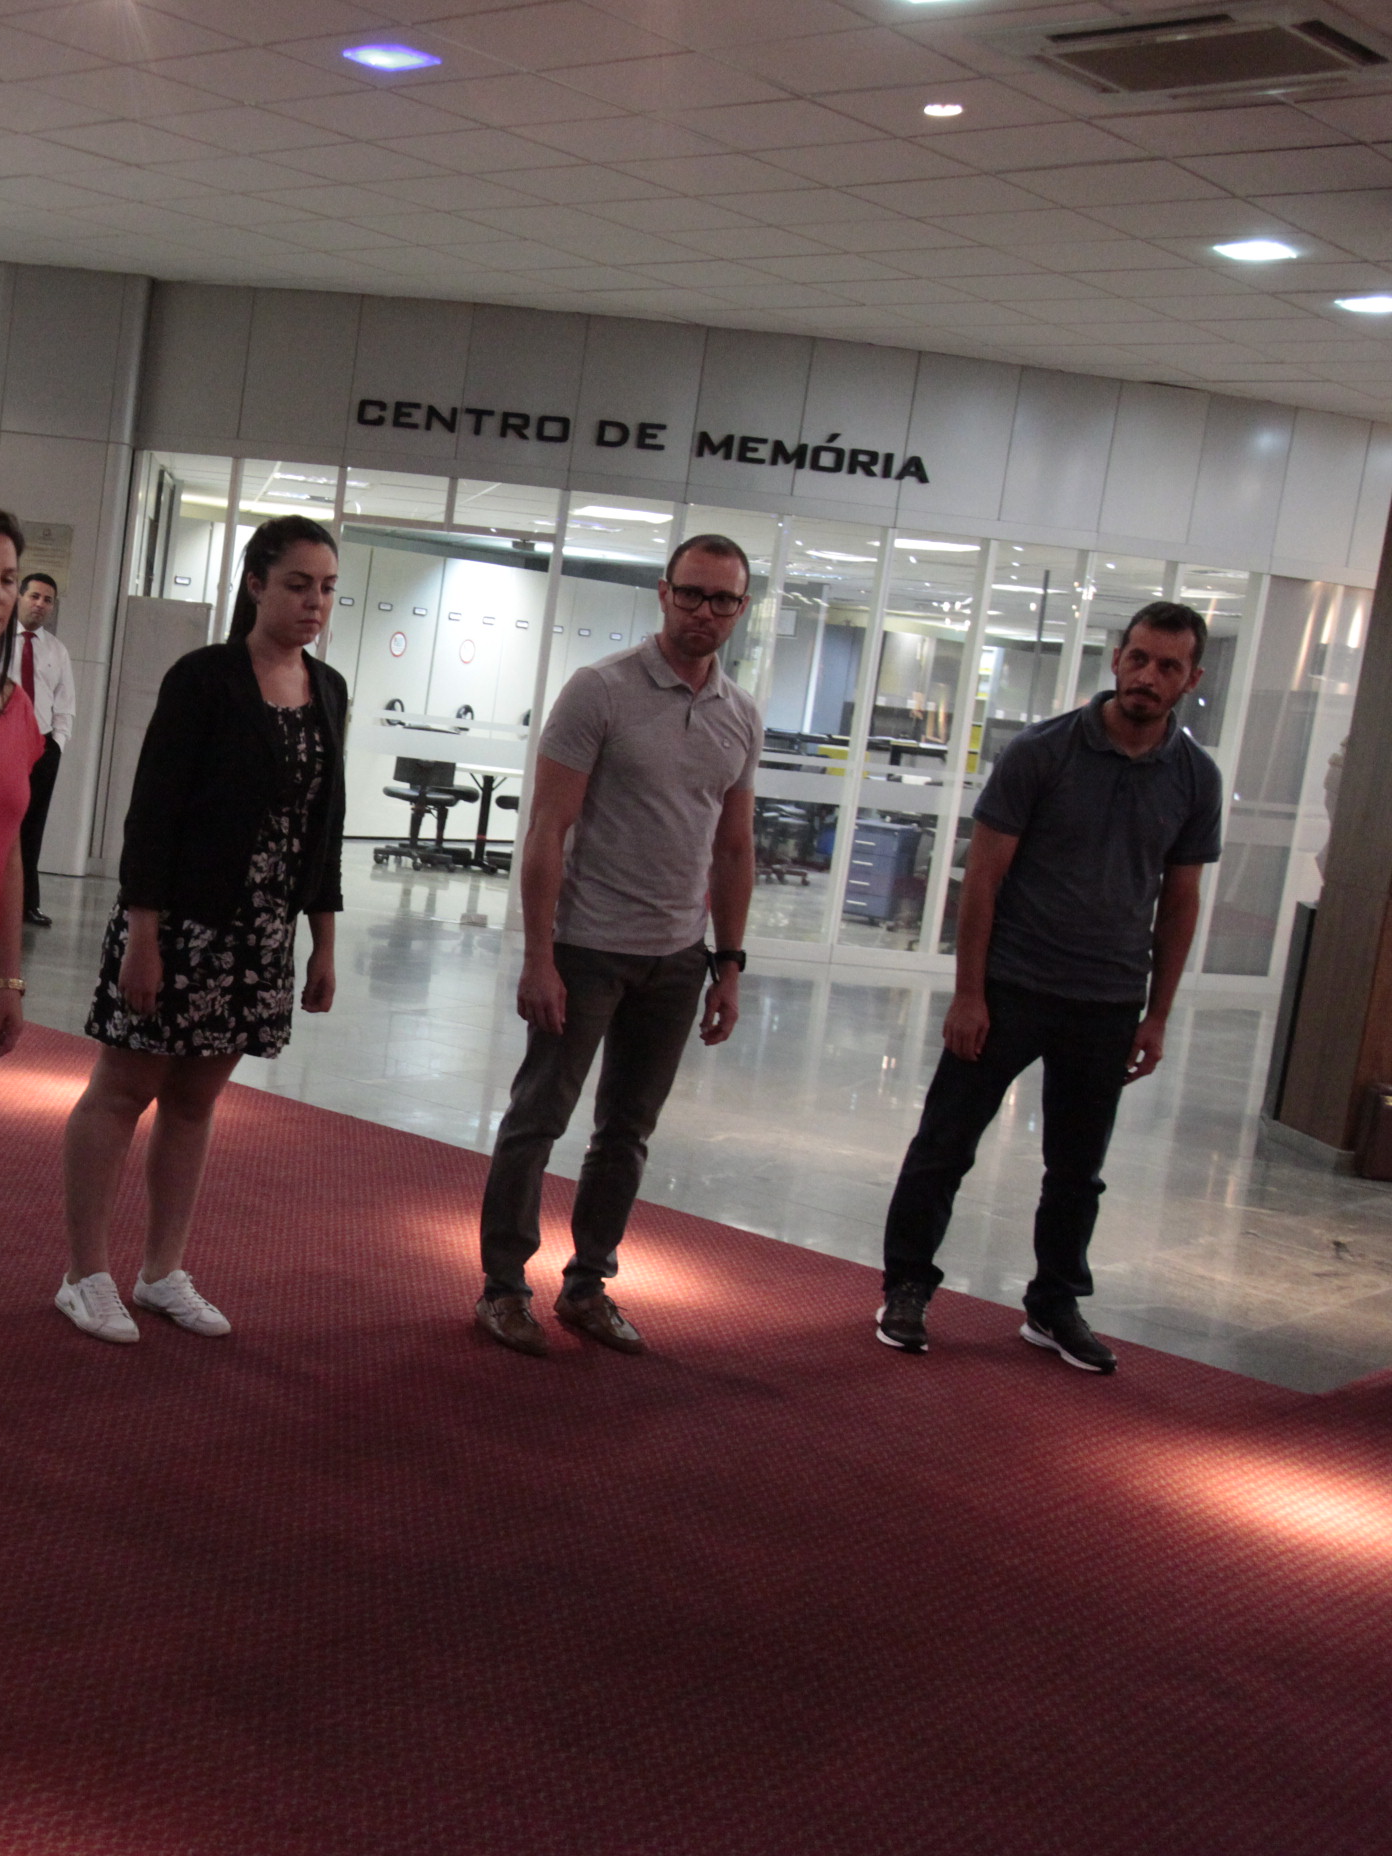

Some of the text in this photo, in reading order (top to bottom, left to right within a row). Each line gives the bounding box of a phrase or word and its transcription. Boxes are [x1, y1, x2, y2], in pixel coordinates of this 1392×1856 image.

[356, 399, 931, 485] CENTRO DE MEMÓRIA
